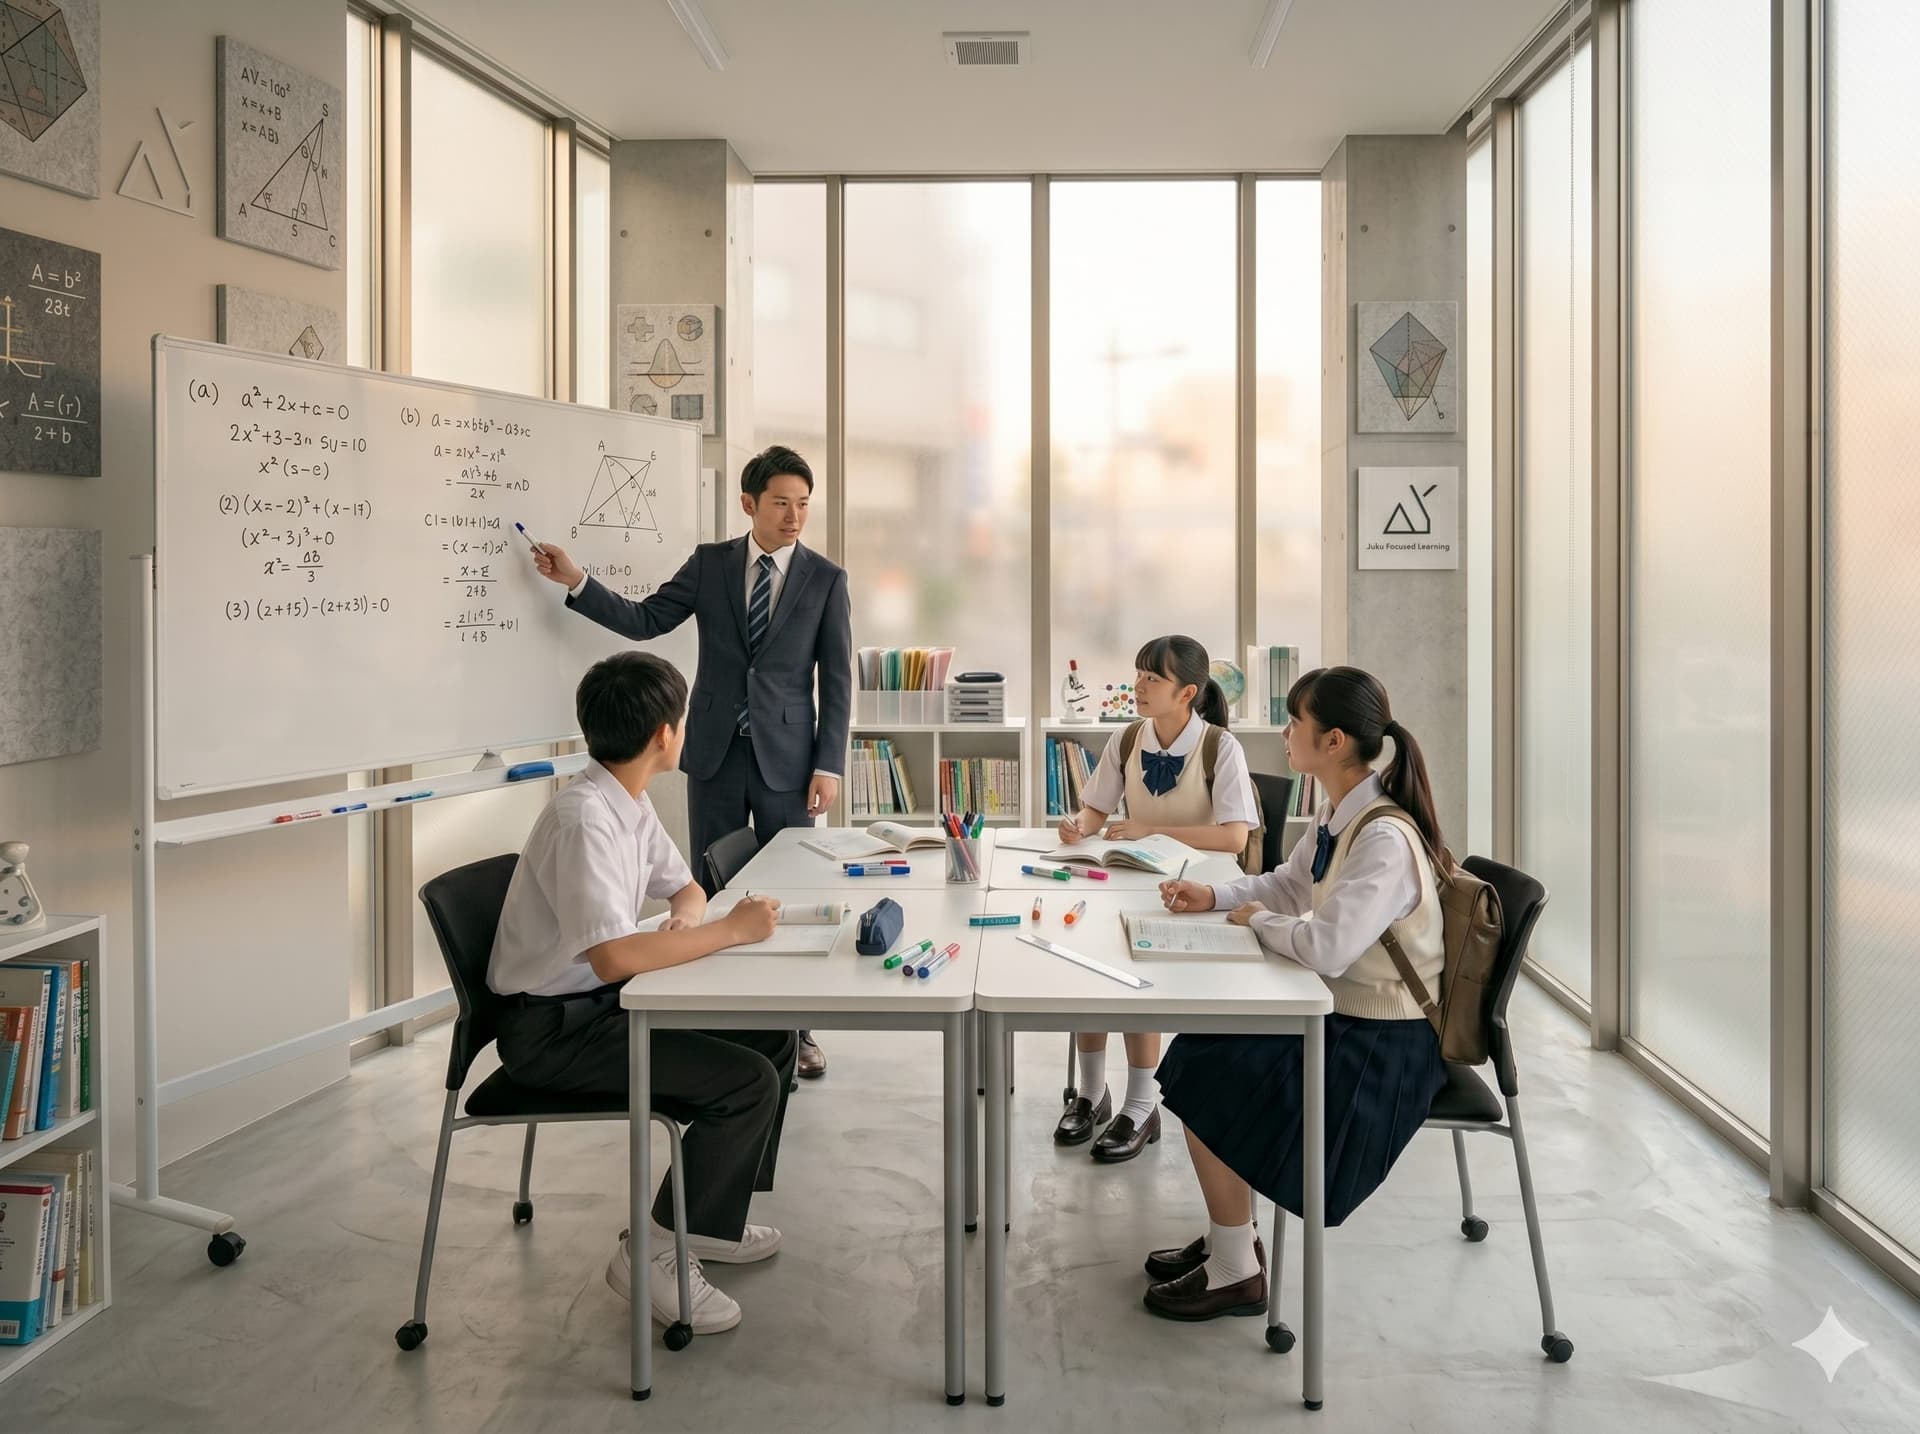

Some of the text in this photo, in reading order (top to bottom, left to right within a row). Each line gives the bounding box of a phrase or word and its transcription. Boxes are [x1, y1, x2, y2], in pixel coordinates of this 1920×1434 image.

[239, 203, 247, 218] A
[329, 235, 336, 247] C
[189, 379, 219, 405] (a)
[400, 408, 421, 427] (b)
[598, 440, 605, 451] A
[571, 526, 577, 539] B
[1418, 543, 1450, 551] Learning
[308, 571, 315, 582] 3
[226, 600, 250, 621] (3)
